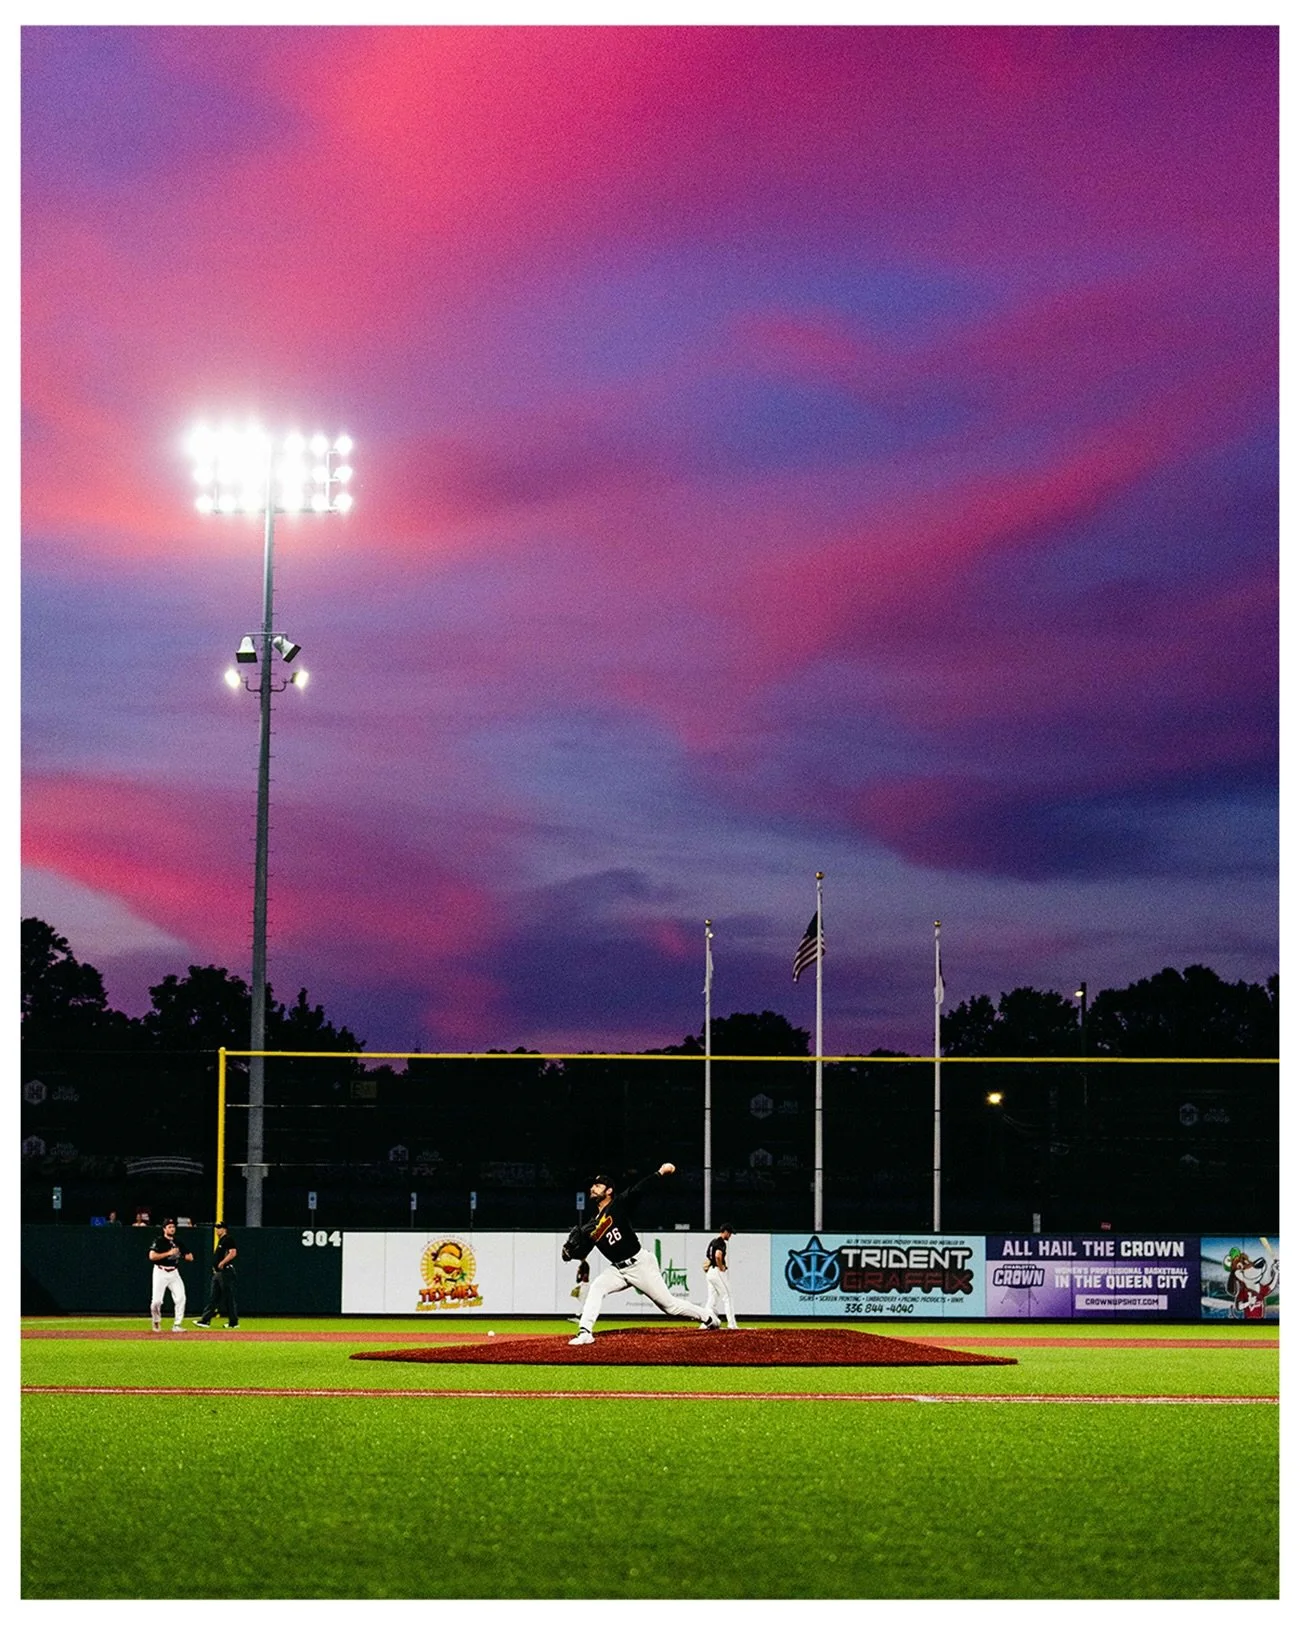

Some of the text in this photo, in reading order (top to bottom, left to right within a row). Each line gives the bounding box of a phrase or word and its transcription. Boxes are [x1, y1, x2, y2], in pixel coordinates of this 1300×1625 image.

[302, 1231, 342, 1247] 304
[605, 1227, 622, 1246] 26
[1002, 1240, 1184, 1257] ALL HAIL THE CROWN
[841, 1248, 970, 1269] TRIDENT
[994, 1269, 1044, 1285] CROWN
[1054, 1267, 1188, 1275] WOMEN'S PROFESSIONAL BASKETBALL
[842, 1271, 972, 1292] GRAFFIX
[1055, 1275, 1189, 1289] IN THE QUEEN CITY
[419, 1283, 479, 1303] TEX-MEX
[845, 1303, 863, 1313] 336
[865, 1303, 883, 1313] 844
[1085, 1298, 1159, 1306] CROWNUPSHOT.COM
